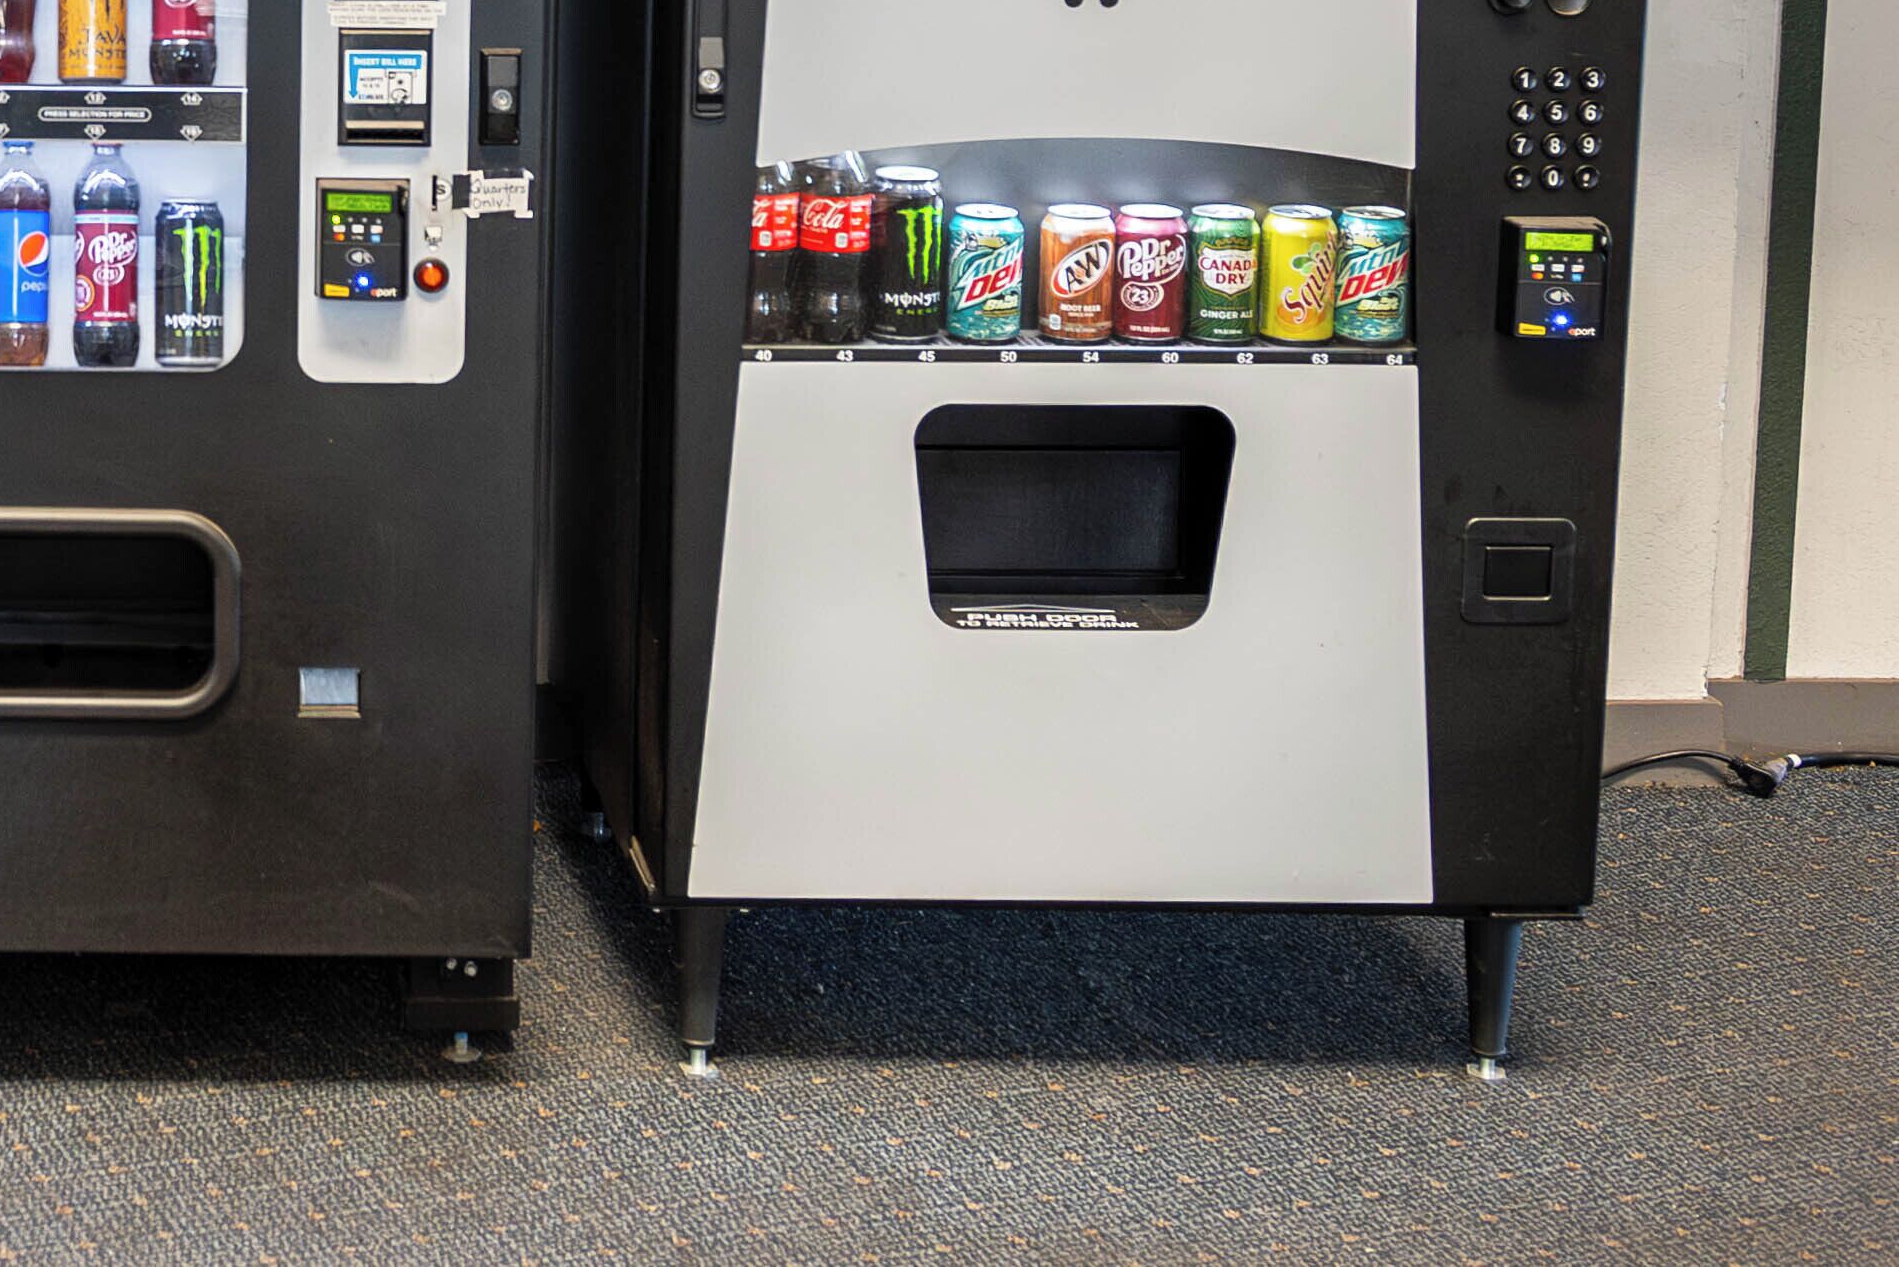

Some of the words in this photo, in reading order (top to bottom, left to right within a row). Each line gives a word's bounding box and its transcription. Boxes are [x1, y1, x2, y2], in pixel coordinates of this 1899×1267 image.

[803, 199, 847, 229] Cola
[108, 231, 127, 248] Dr
[1141, 238, 1171, 258] Dr
[1122, 242, 1185, 282] Pepper
[1215, 272, 1248, 285] DRY
[1132, 289, 1149, 304] 23
[1200, 310, 1238, 319] GINGER
[755, 350, 772, 362] 40
[836, 350, 854, 362] 43
[918, 350, 936, 362] 45
[1000, 350, 1017, 362] 50
[1082, 351, 1099, 362] 54
[1161, 352, 1179, 363] 60
[1236, 352, 1254, 363] 62
[1312, 353, 1329, 364] 63
[1386, 354, 1403, 366] 64
[967, 613, 1037, 622] PUSH
[1046, 614, 1116, 622] DOOR
